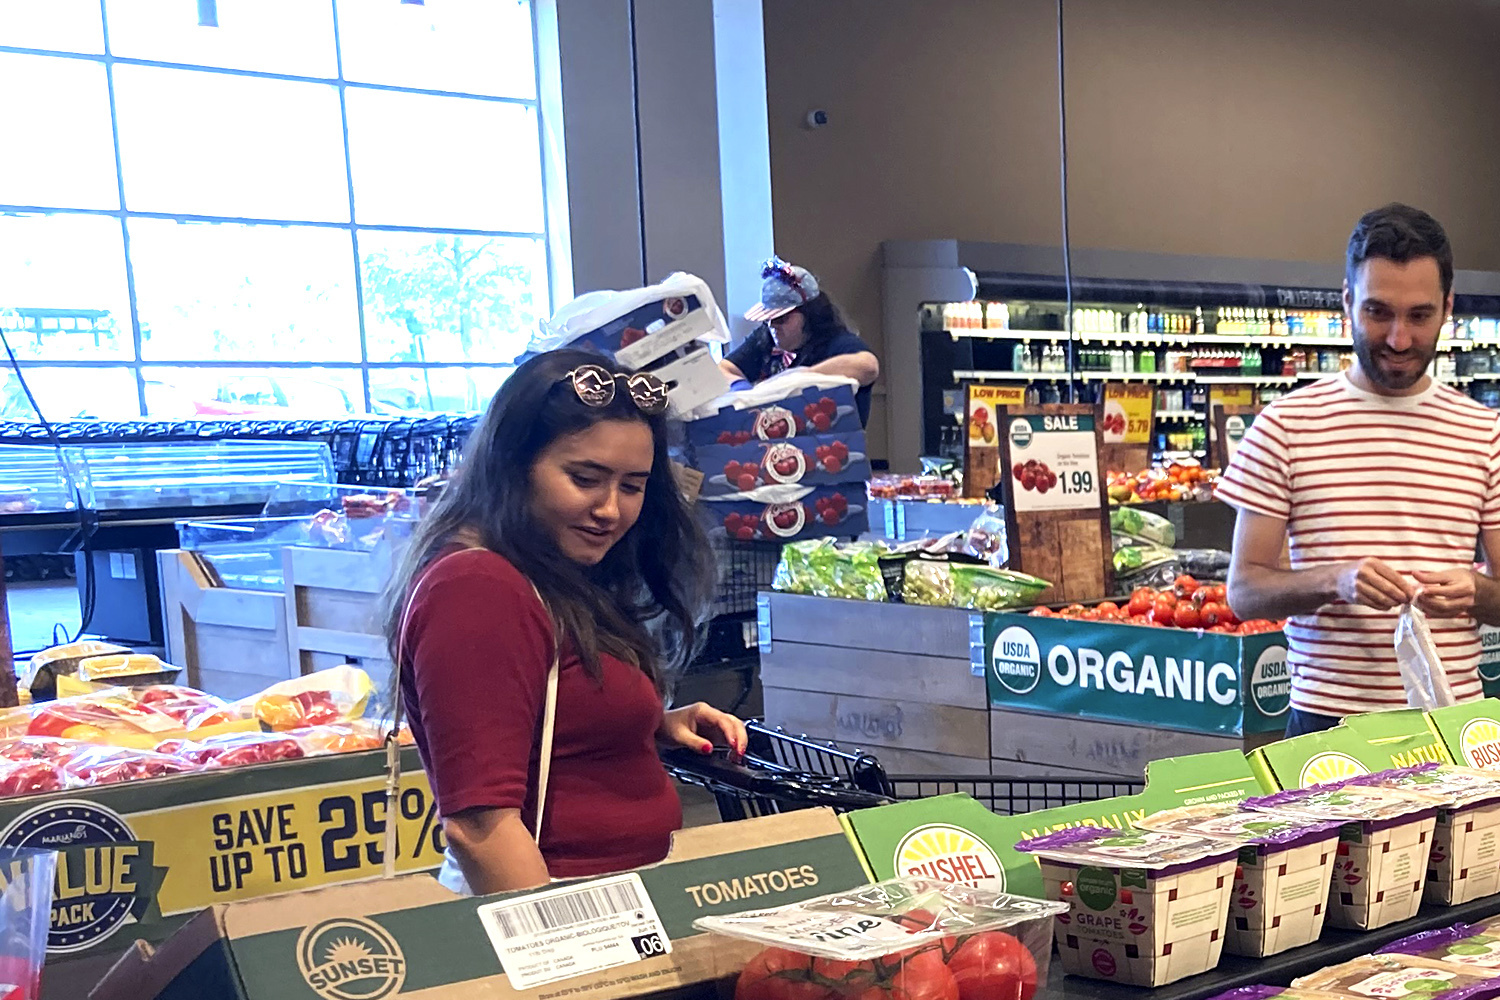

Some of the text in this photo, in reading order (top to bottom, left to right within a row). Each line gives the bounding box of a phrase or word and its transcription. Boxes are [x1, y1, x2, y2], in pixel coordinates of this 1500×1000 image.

[973, 388, 1021, 399] LOW PRICE
[1107, 388, 1124, 399] LOW
[1043, 415, 1079, 431] SALE
[1058, 470, 1093, 494] 1.99
[1002, 641, 1031, 659] USDA
[997, 660, 1036, 678] ORGANIC
[1047, 644, 1238, 706] ORGANIC
[1261, 660, 1288, 678] USDA
[1257, 682, 1291, 699] ORGANIC
[1184, 794, 1206, 806] GROWN
[1206, 793, 1218, 803] AND
[1236, 788, 1246, 797] BY
[212, 803, 298, 851] SAVE
[318, 787, 447, 874] 25%
[0, 845, 139, 901] VALUE
[208, 841, 308, 893] UP TO
[685, 864, 819, 908] TOMATOES
[1078, 882, 1115, 899] organic
[49, 903, 95, 928] PACK
[1076, 912, 1123, 930] GRAPE
[1076, 924, 1126, 940] TOMATOES
[506, 940, 545, 955] TOMATOES
[639, 934, 665, 956] 06
[307, 954, 406, 992] SUNSET
